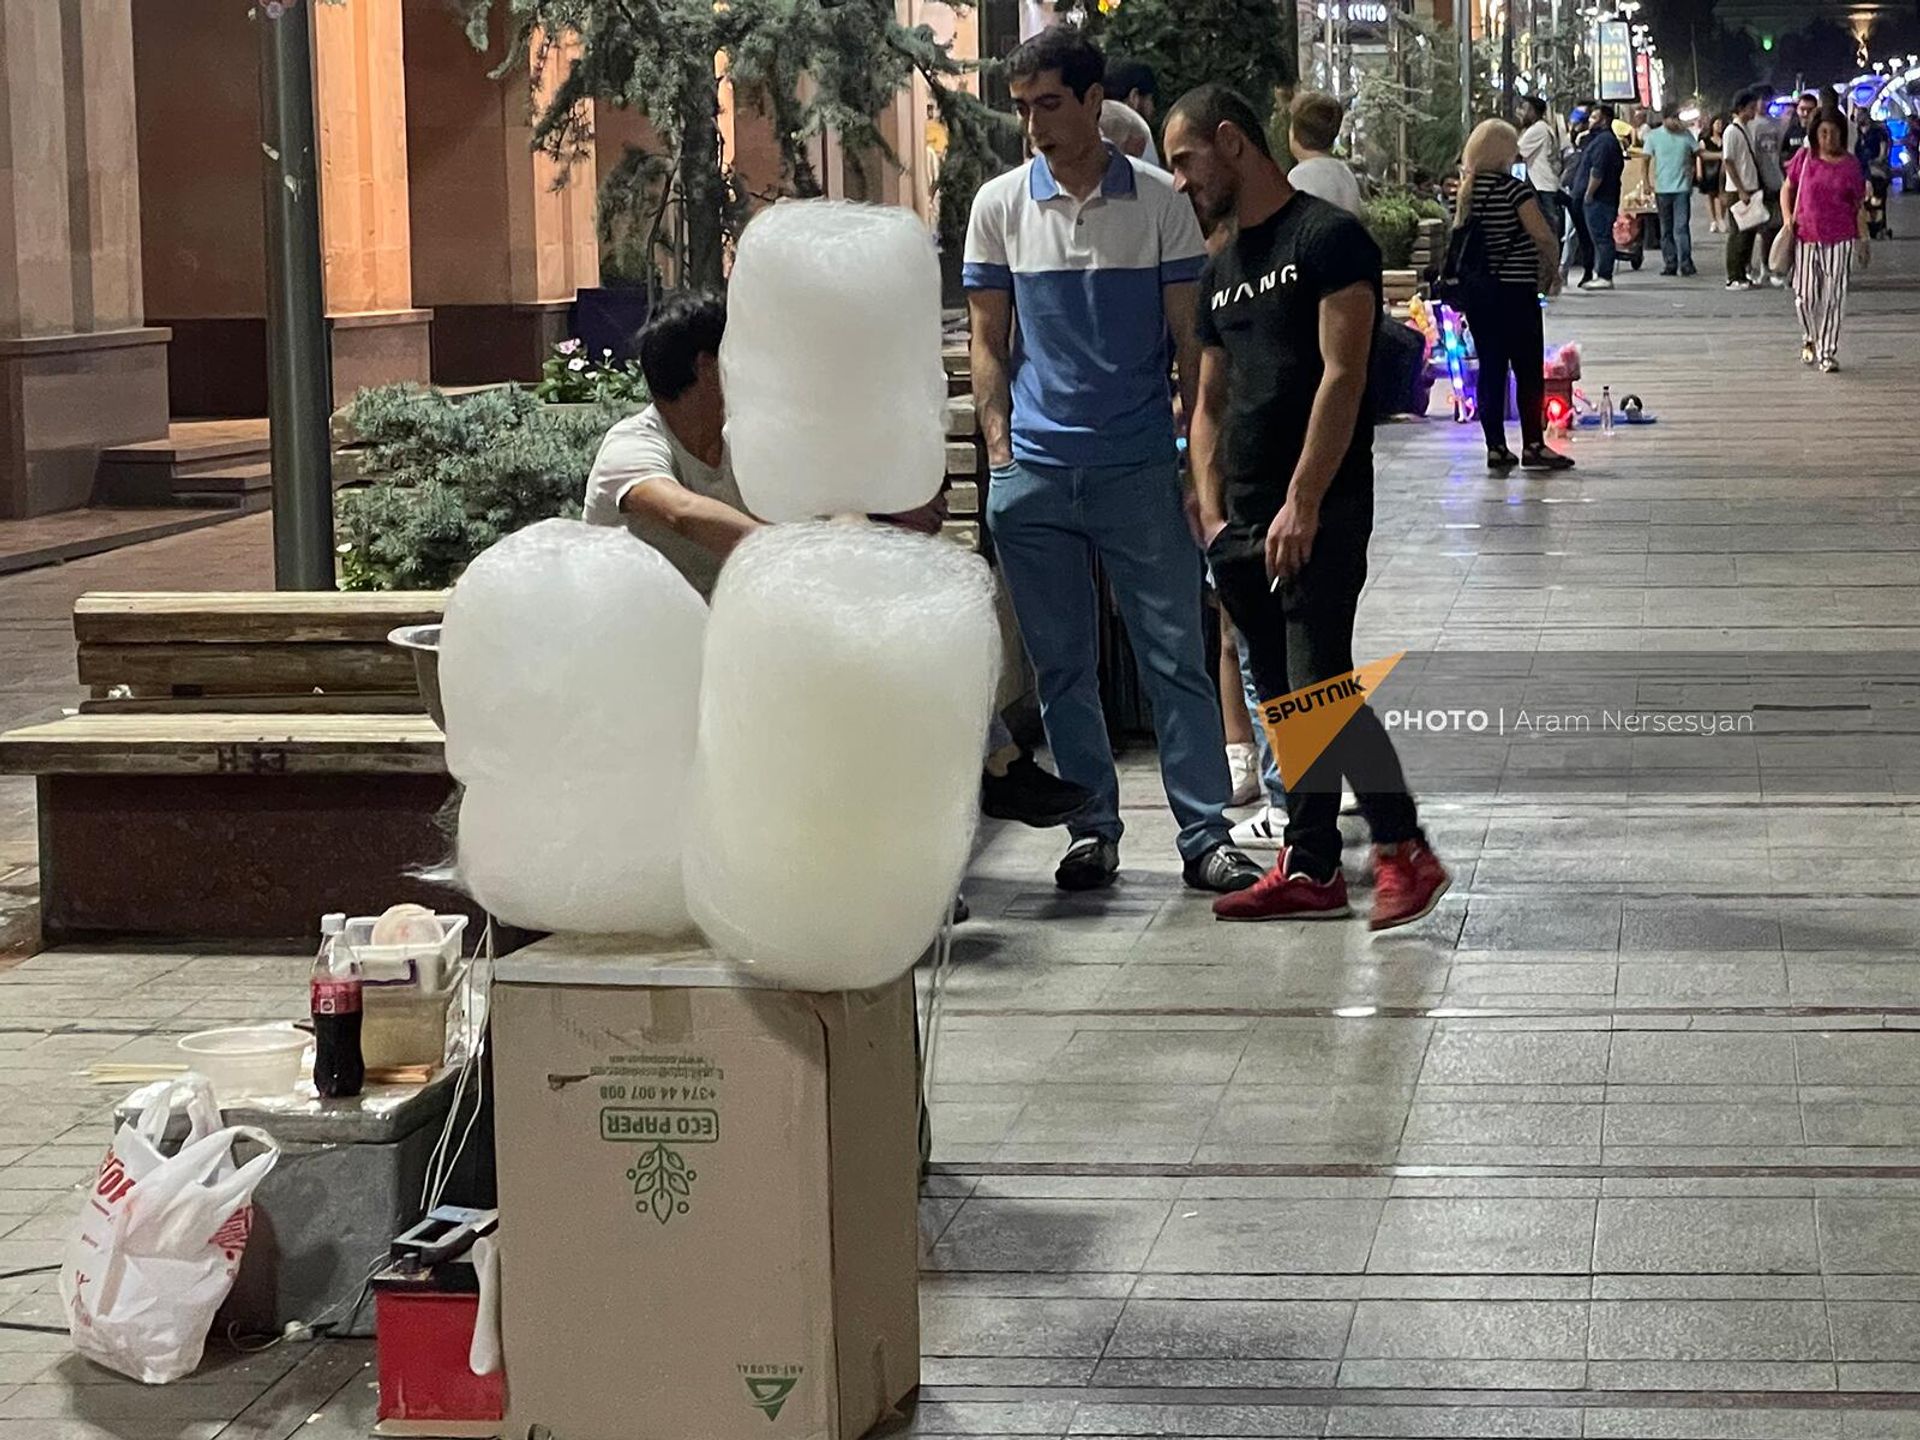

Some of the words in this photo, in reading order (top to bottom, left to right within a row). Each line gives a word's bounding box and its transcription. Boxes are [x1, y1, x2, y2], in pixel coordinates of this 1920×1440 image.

[600, 1085, 626, 1099] 008
[631, 1086, 656, 1101] 007
[660, 1086, 678, 1101] 44
[682, 1086, 717, 1101] +374
[607, 1115, 671, 1135] PAPER
[677, 1116, 713, 1135] ECO
